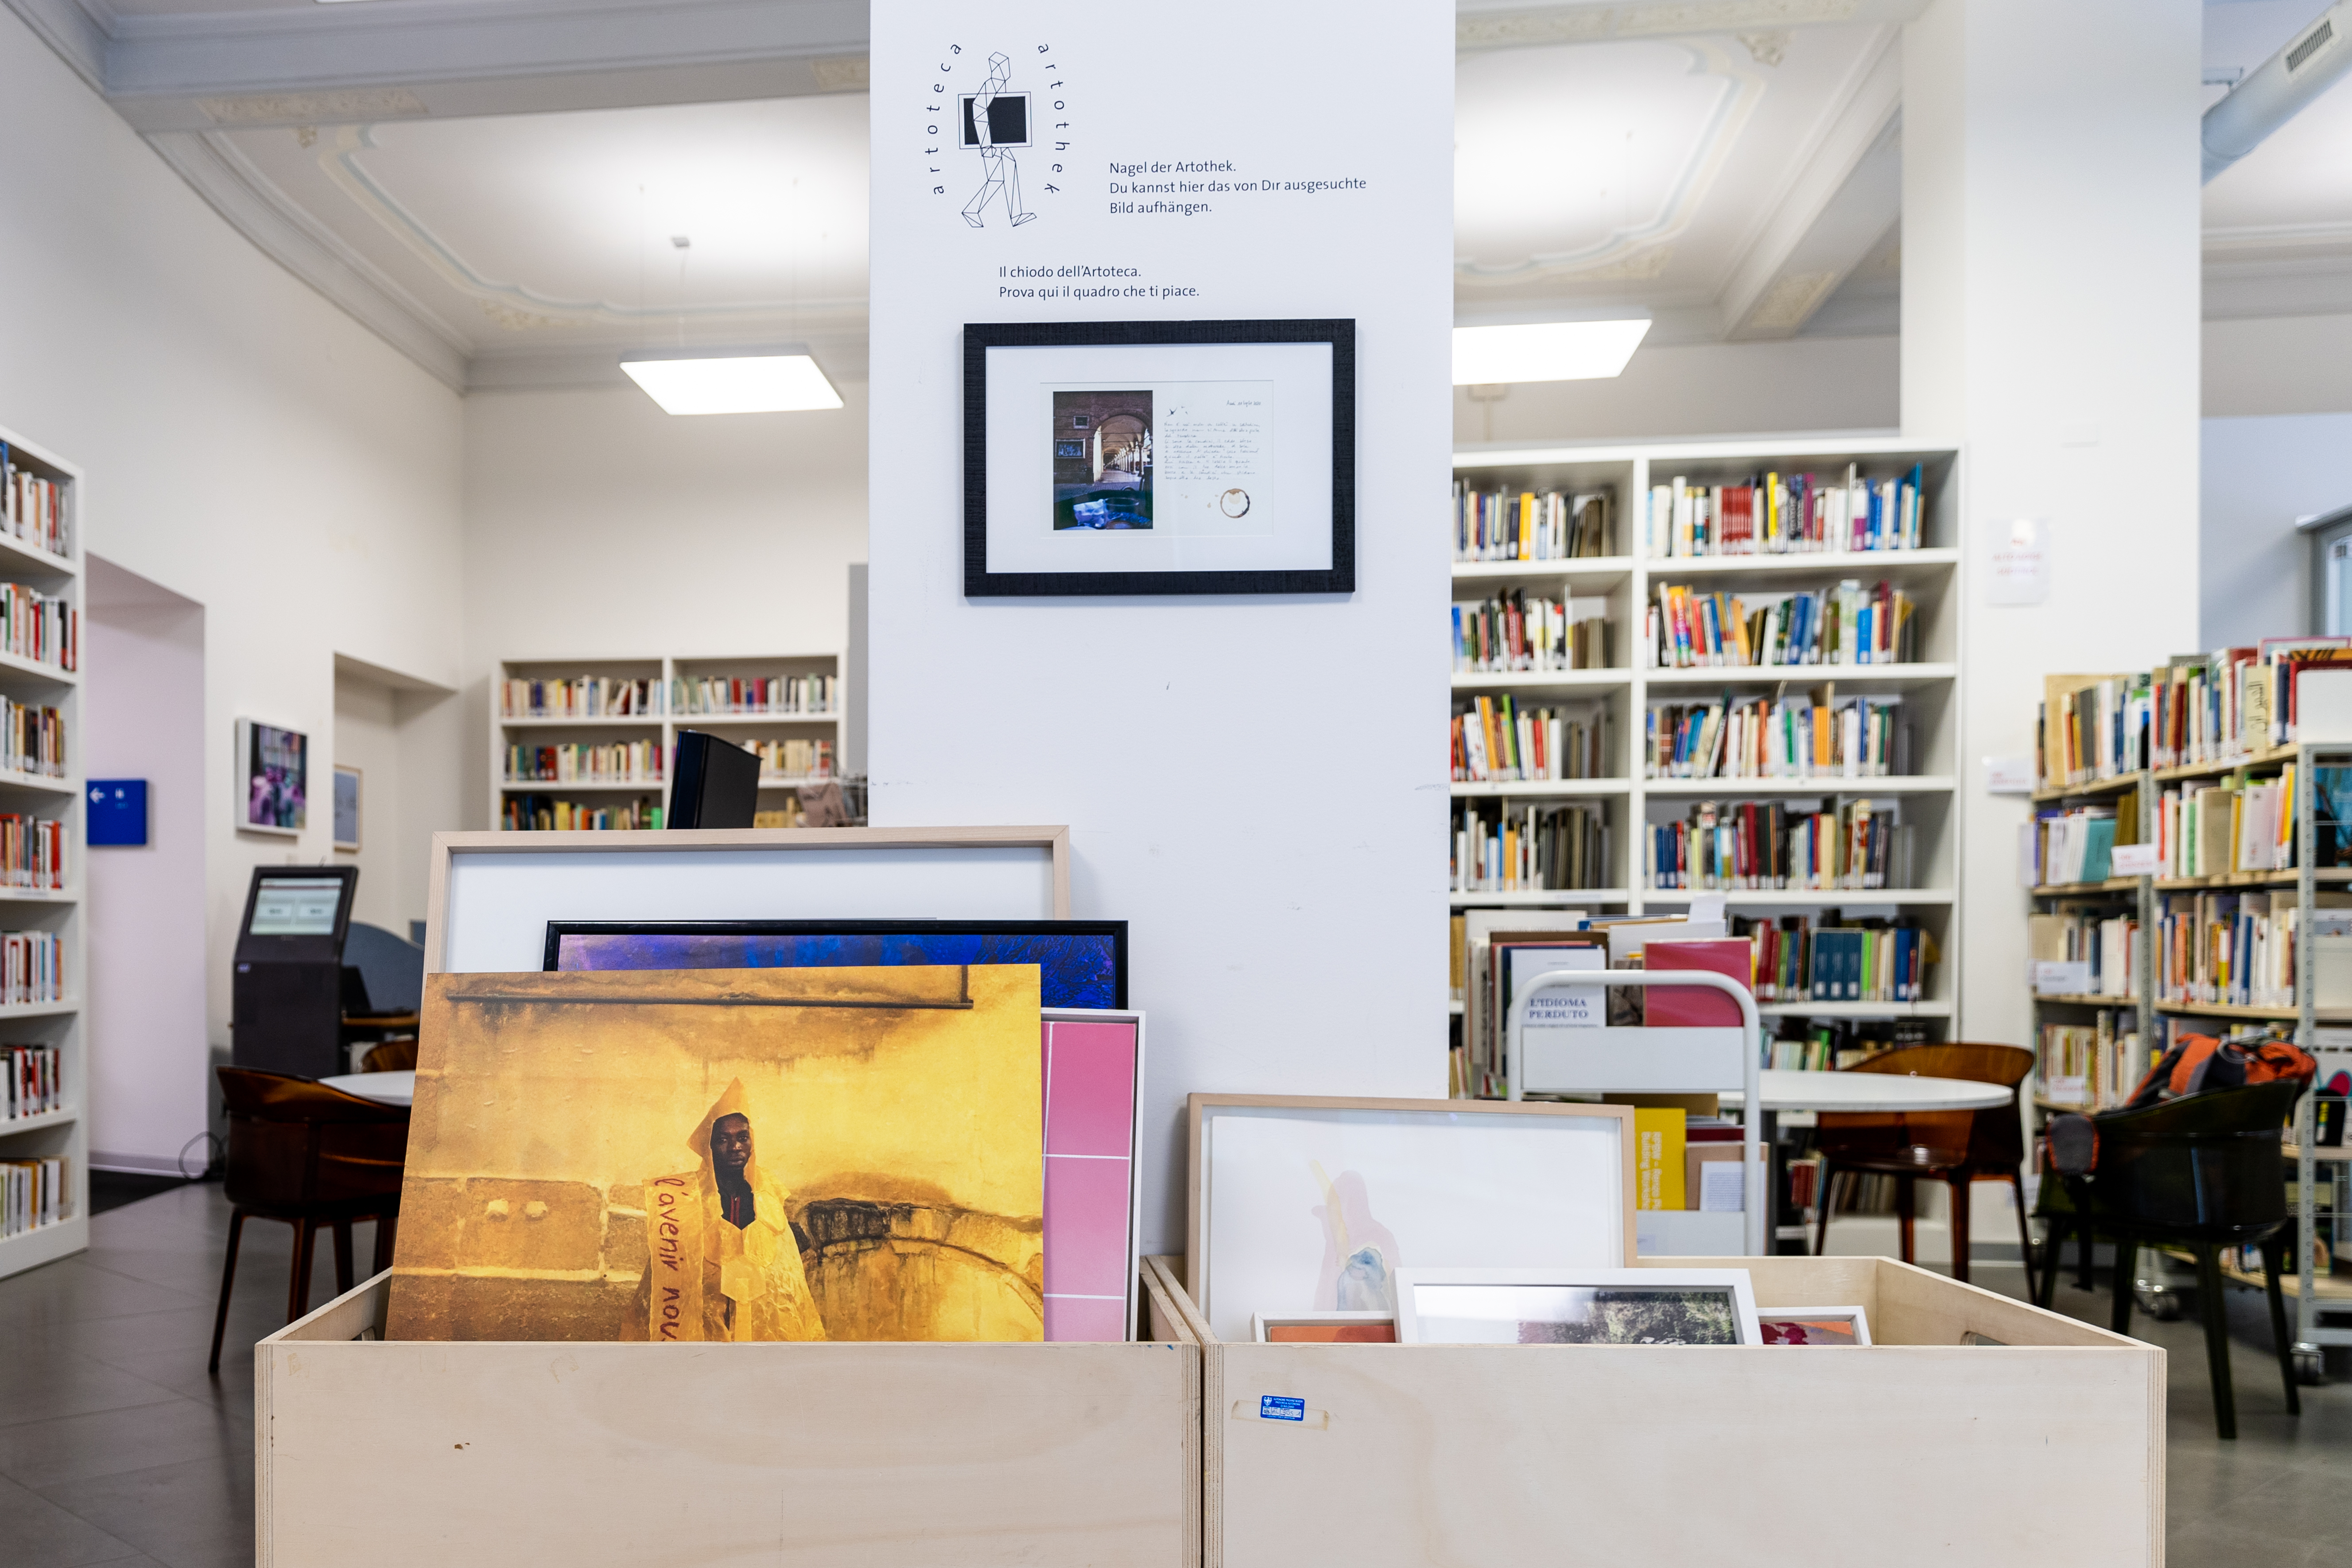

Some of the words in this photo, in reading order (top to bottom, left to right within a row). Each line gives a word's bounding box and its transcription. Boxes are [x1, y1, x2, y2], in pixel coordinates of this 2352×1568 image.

[924, 43, 962, 195] artoteca
[1038, 43, 1070, 194] artothek
[1110, 161, 1147, 177] Nagel
[1151, 161, 1172, 173] der
[1175, 159, 1236, 172] Artothek.
[1110, 182, 1127, 194] Du
[1132, 181, 1175, 193] kannst
[1180, 181, 1204, 192] hier
[1208, 180, 1230, 192] das
[1234, 182, 1257, 191] von
[1284, 177, 1366, 194] ausgesuchte
[1110, 202, 1133, 213] Bild
[1137, 201, 1212, 216] aufhängen.
[1000, 266, 1006, 278] Il
[1010, 265, 1053, 278] chiodo
[1000, 287, 1034, 298] Prova
[1038, 286, 1058, 301] qui
[1063, 285, 1069, 297] il
[1074, 285, 1120, 301] quadro
[1123, 285, 1145, 297] che
[1149, 285, 1158, 297] ti
[1163, 285, 1199, 300] piace.
[1529, 1009, 1589, 1019] PERDUTO
[1640, 1132, 1650, 1169] Building
